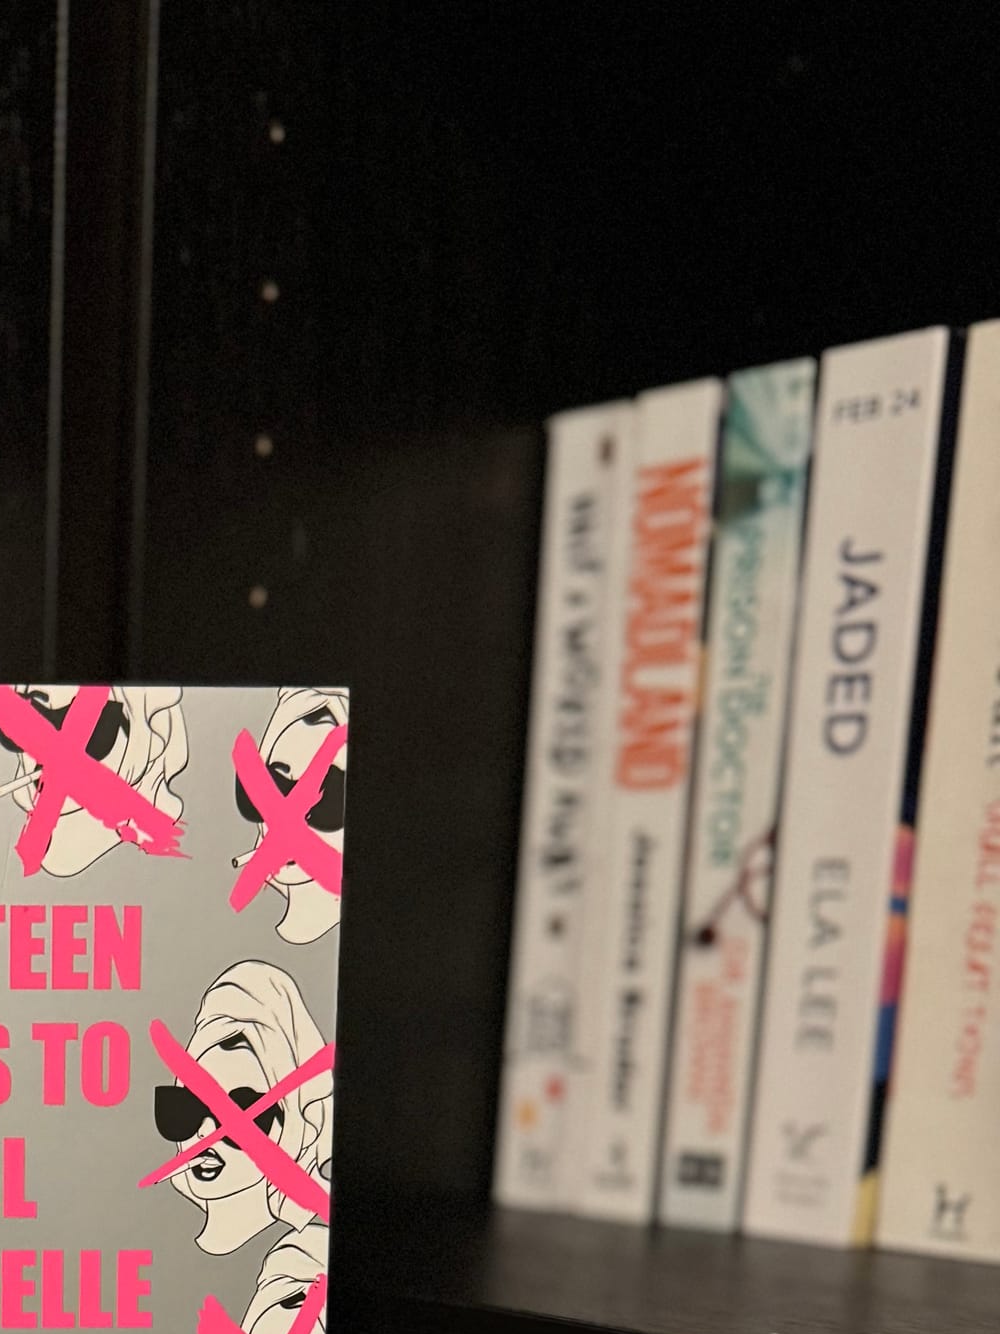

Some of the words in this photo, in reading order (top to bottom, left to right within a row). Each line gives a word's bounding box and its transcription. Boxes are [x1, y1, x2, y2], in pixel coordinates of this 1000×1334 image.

[832, 392, 880, 422] FEB
[888, 387, 921, 416] 24
[613, 455, 708, 792] NOMADLAND
[724, 524, 765, 681] PRISON
[823, 536, 885, 756] JADED
[708, 688, 750, 867] DOCTOR
[806, 856, 850, 949] ELA
[32, 1020, 132, 1107] TO
[796, 970, 841, 1053] LEE
